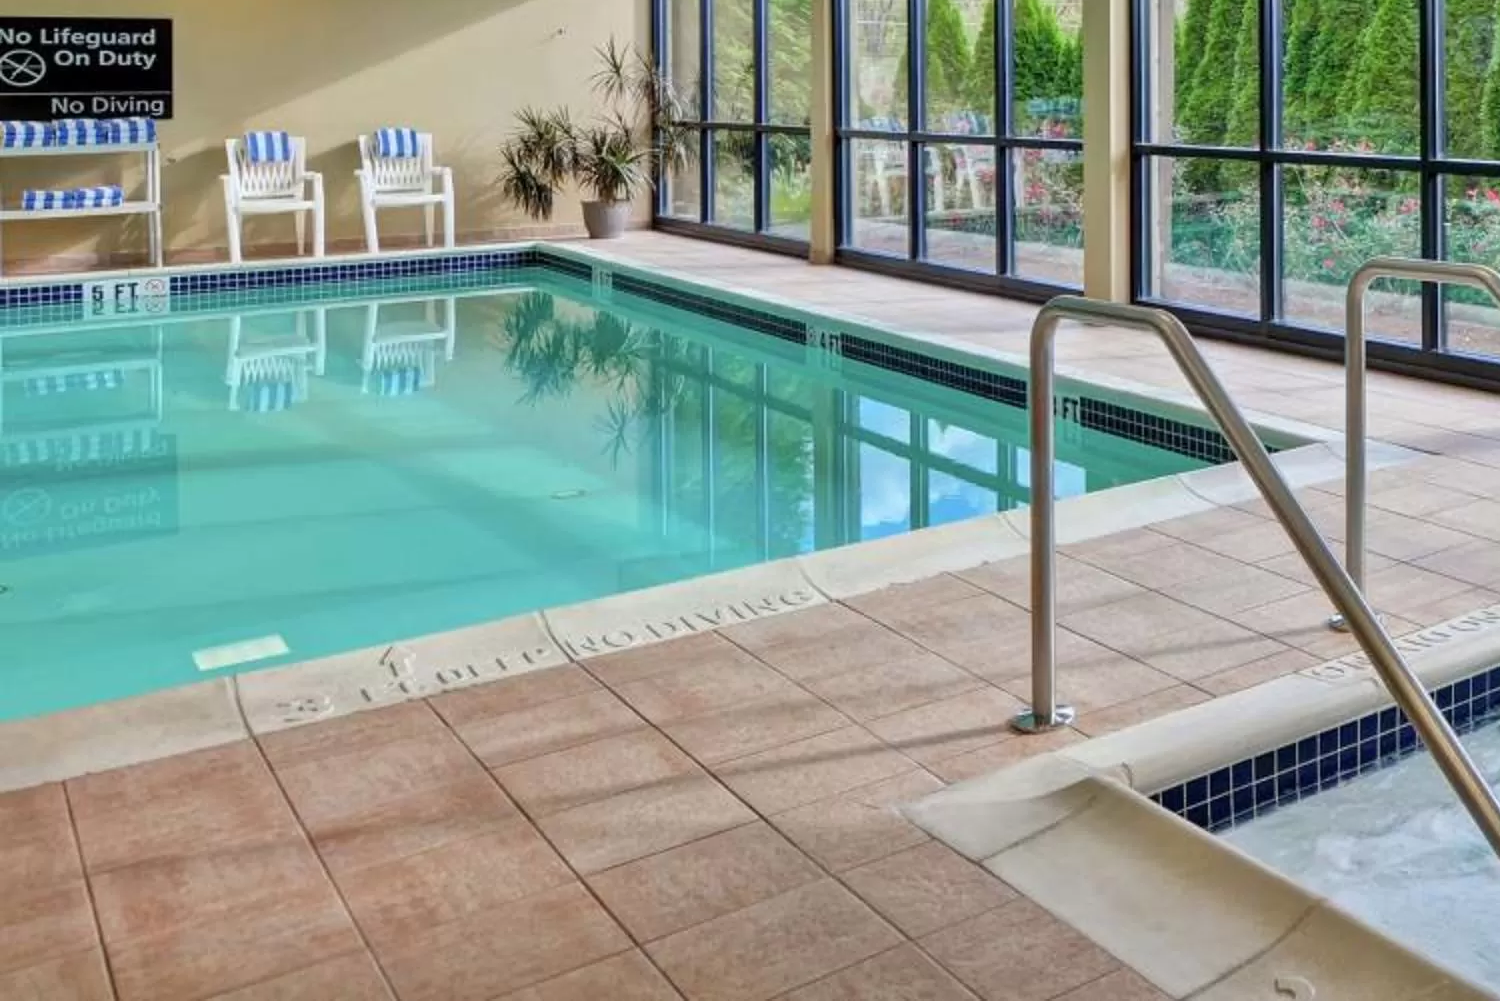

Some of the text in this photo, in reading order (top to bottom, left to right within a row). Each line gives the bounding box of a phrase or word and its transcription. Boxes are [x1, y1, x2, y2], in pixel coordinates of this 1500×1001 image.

[0, 28, 156, 49] No Lifeguard
[54, 50, 156, 70] On Duty
[51, 96, 164, 116] No Diving
[115, 282, 139, 300] FT
[1062, 396, 1079, 423] FT
